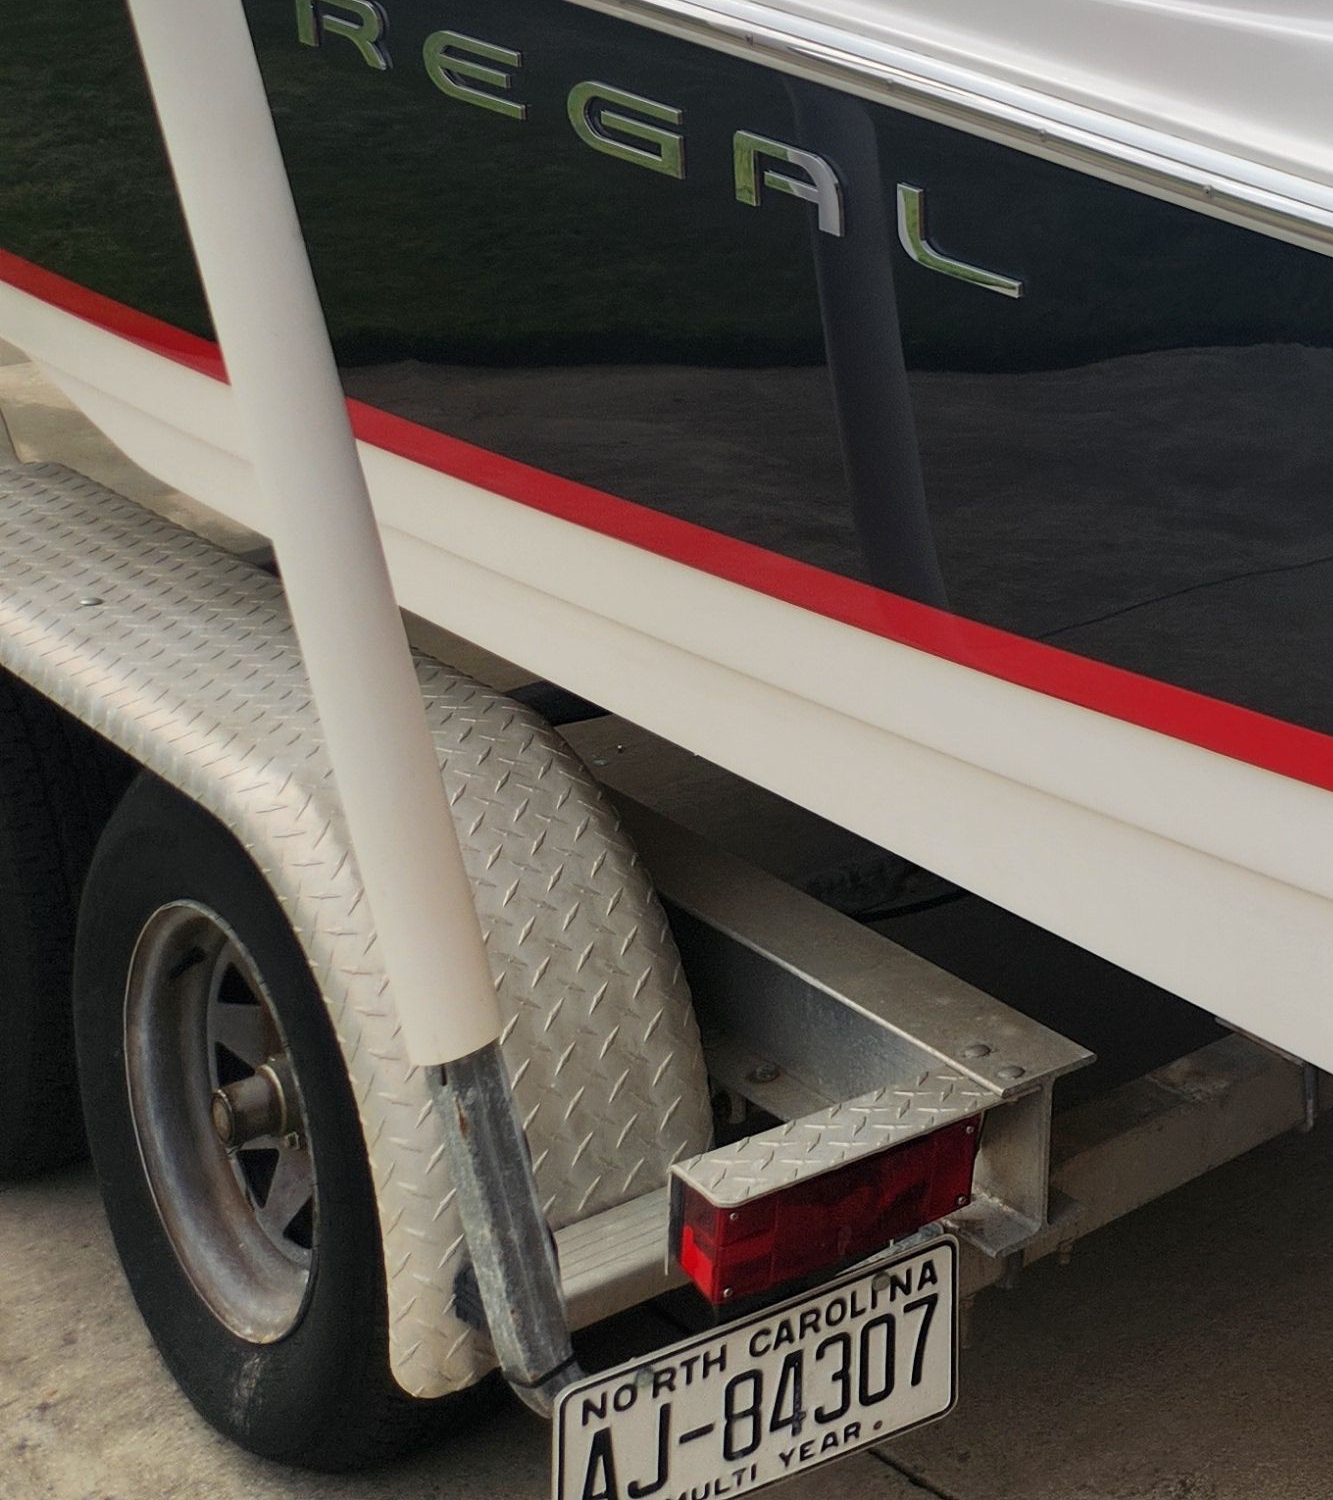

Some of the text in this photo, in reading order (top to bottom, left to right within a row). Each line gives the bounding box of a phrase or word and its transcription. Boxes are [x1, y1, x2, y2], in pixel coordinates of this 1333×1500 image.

[581, 1293, 939, 1500] AJ-84307
[582, 1259, 938, 1428] NORTH CAROLINA
[666, 1421, 861, 1500] ULTI YEAR
